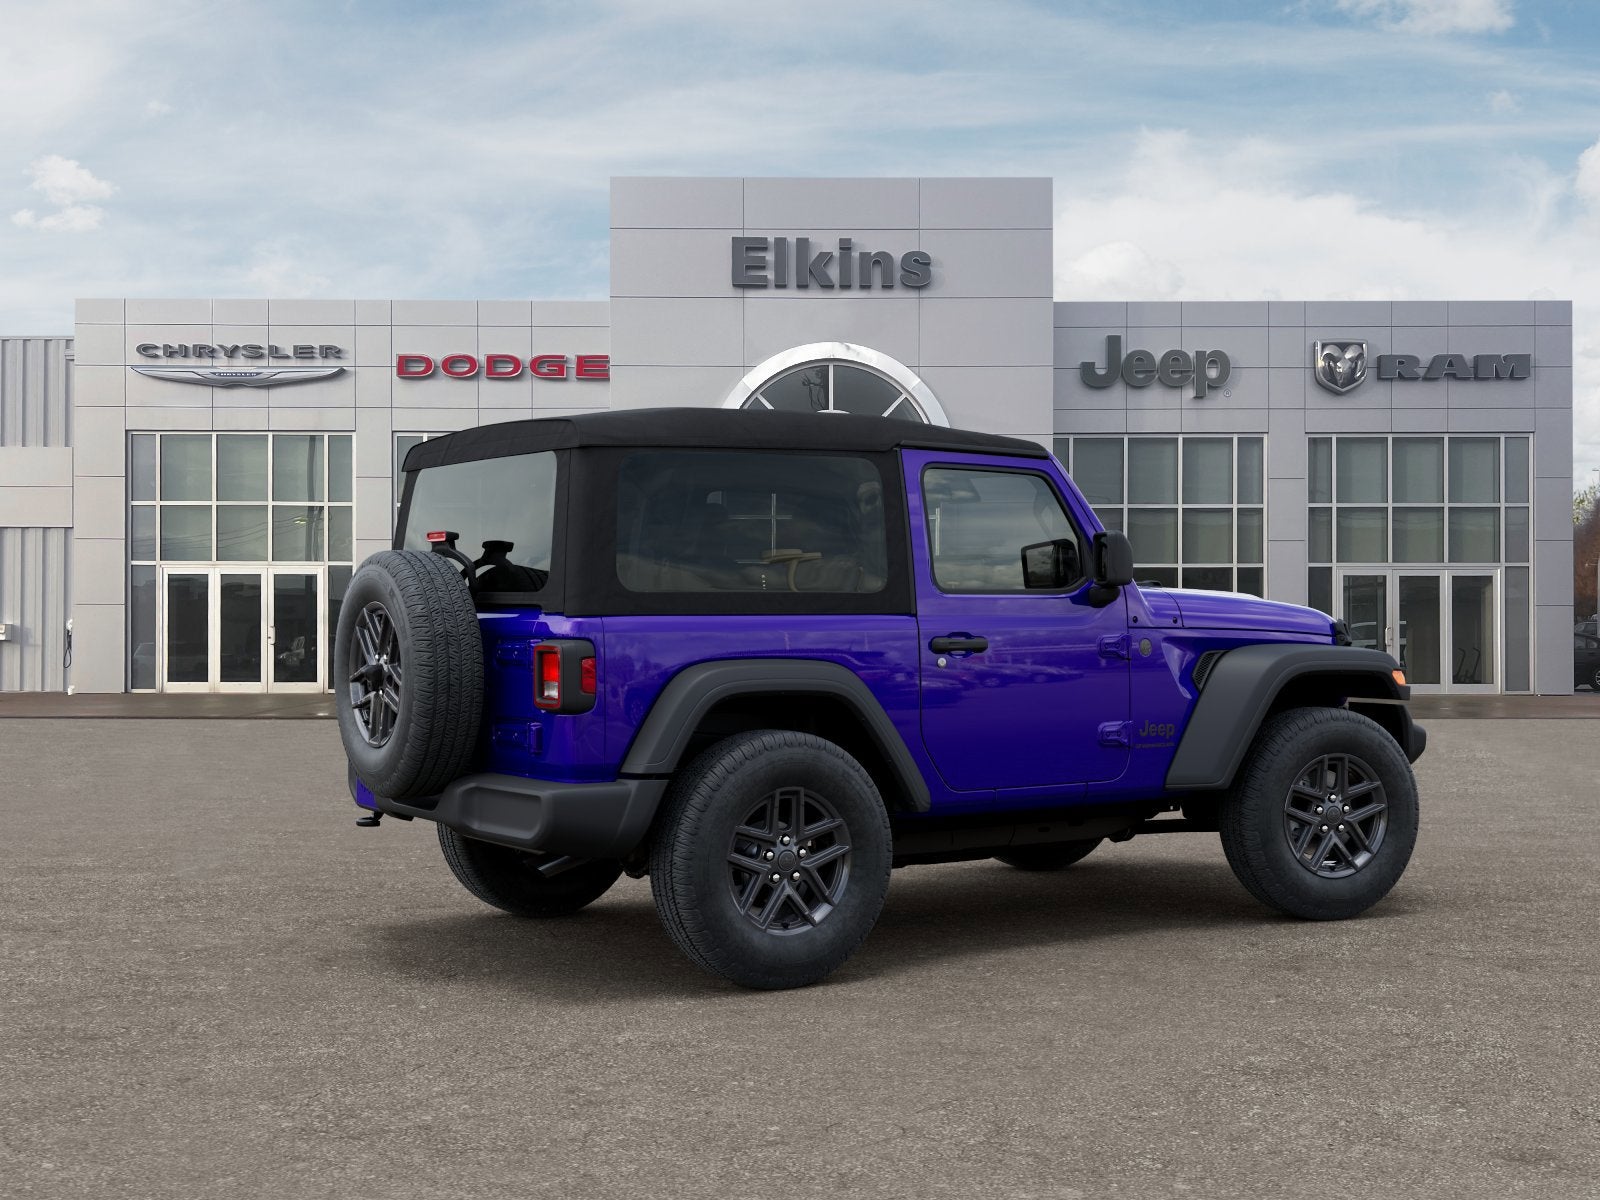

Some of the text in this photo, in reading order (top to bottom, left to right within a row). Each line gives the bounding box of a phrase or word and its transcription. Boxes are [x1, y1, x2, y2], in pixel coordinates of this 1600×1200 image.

[731, 236, 932, 288] Elkins
[136, 342, 343, 359] CHRYSLER
[396, 353, 611, 379] DODGE
[1080, 335, 1231, 398] Jeep
[1377, 353, 1532, 381] RAM
[1139, 720, 1175, 739] Jeep
